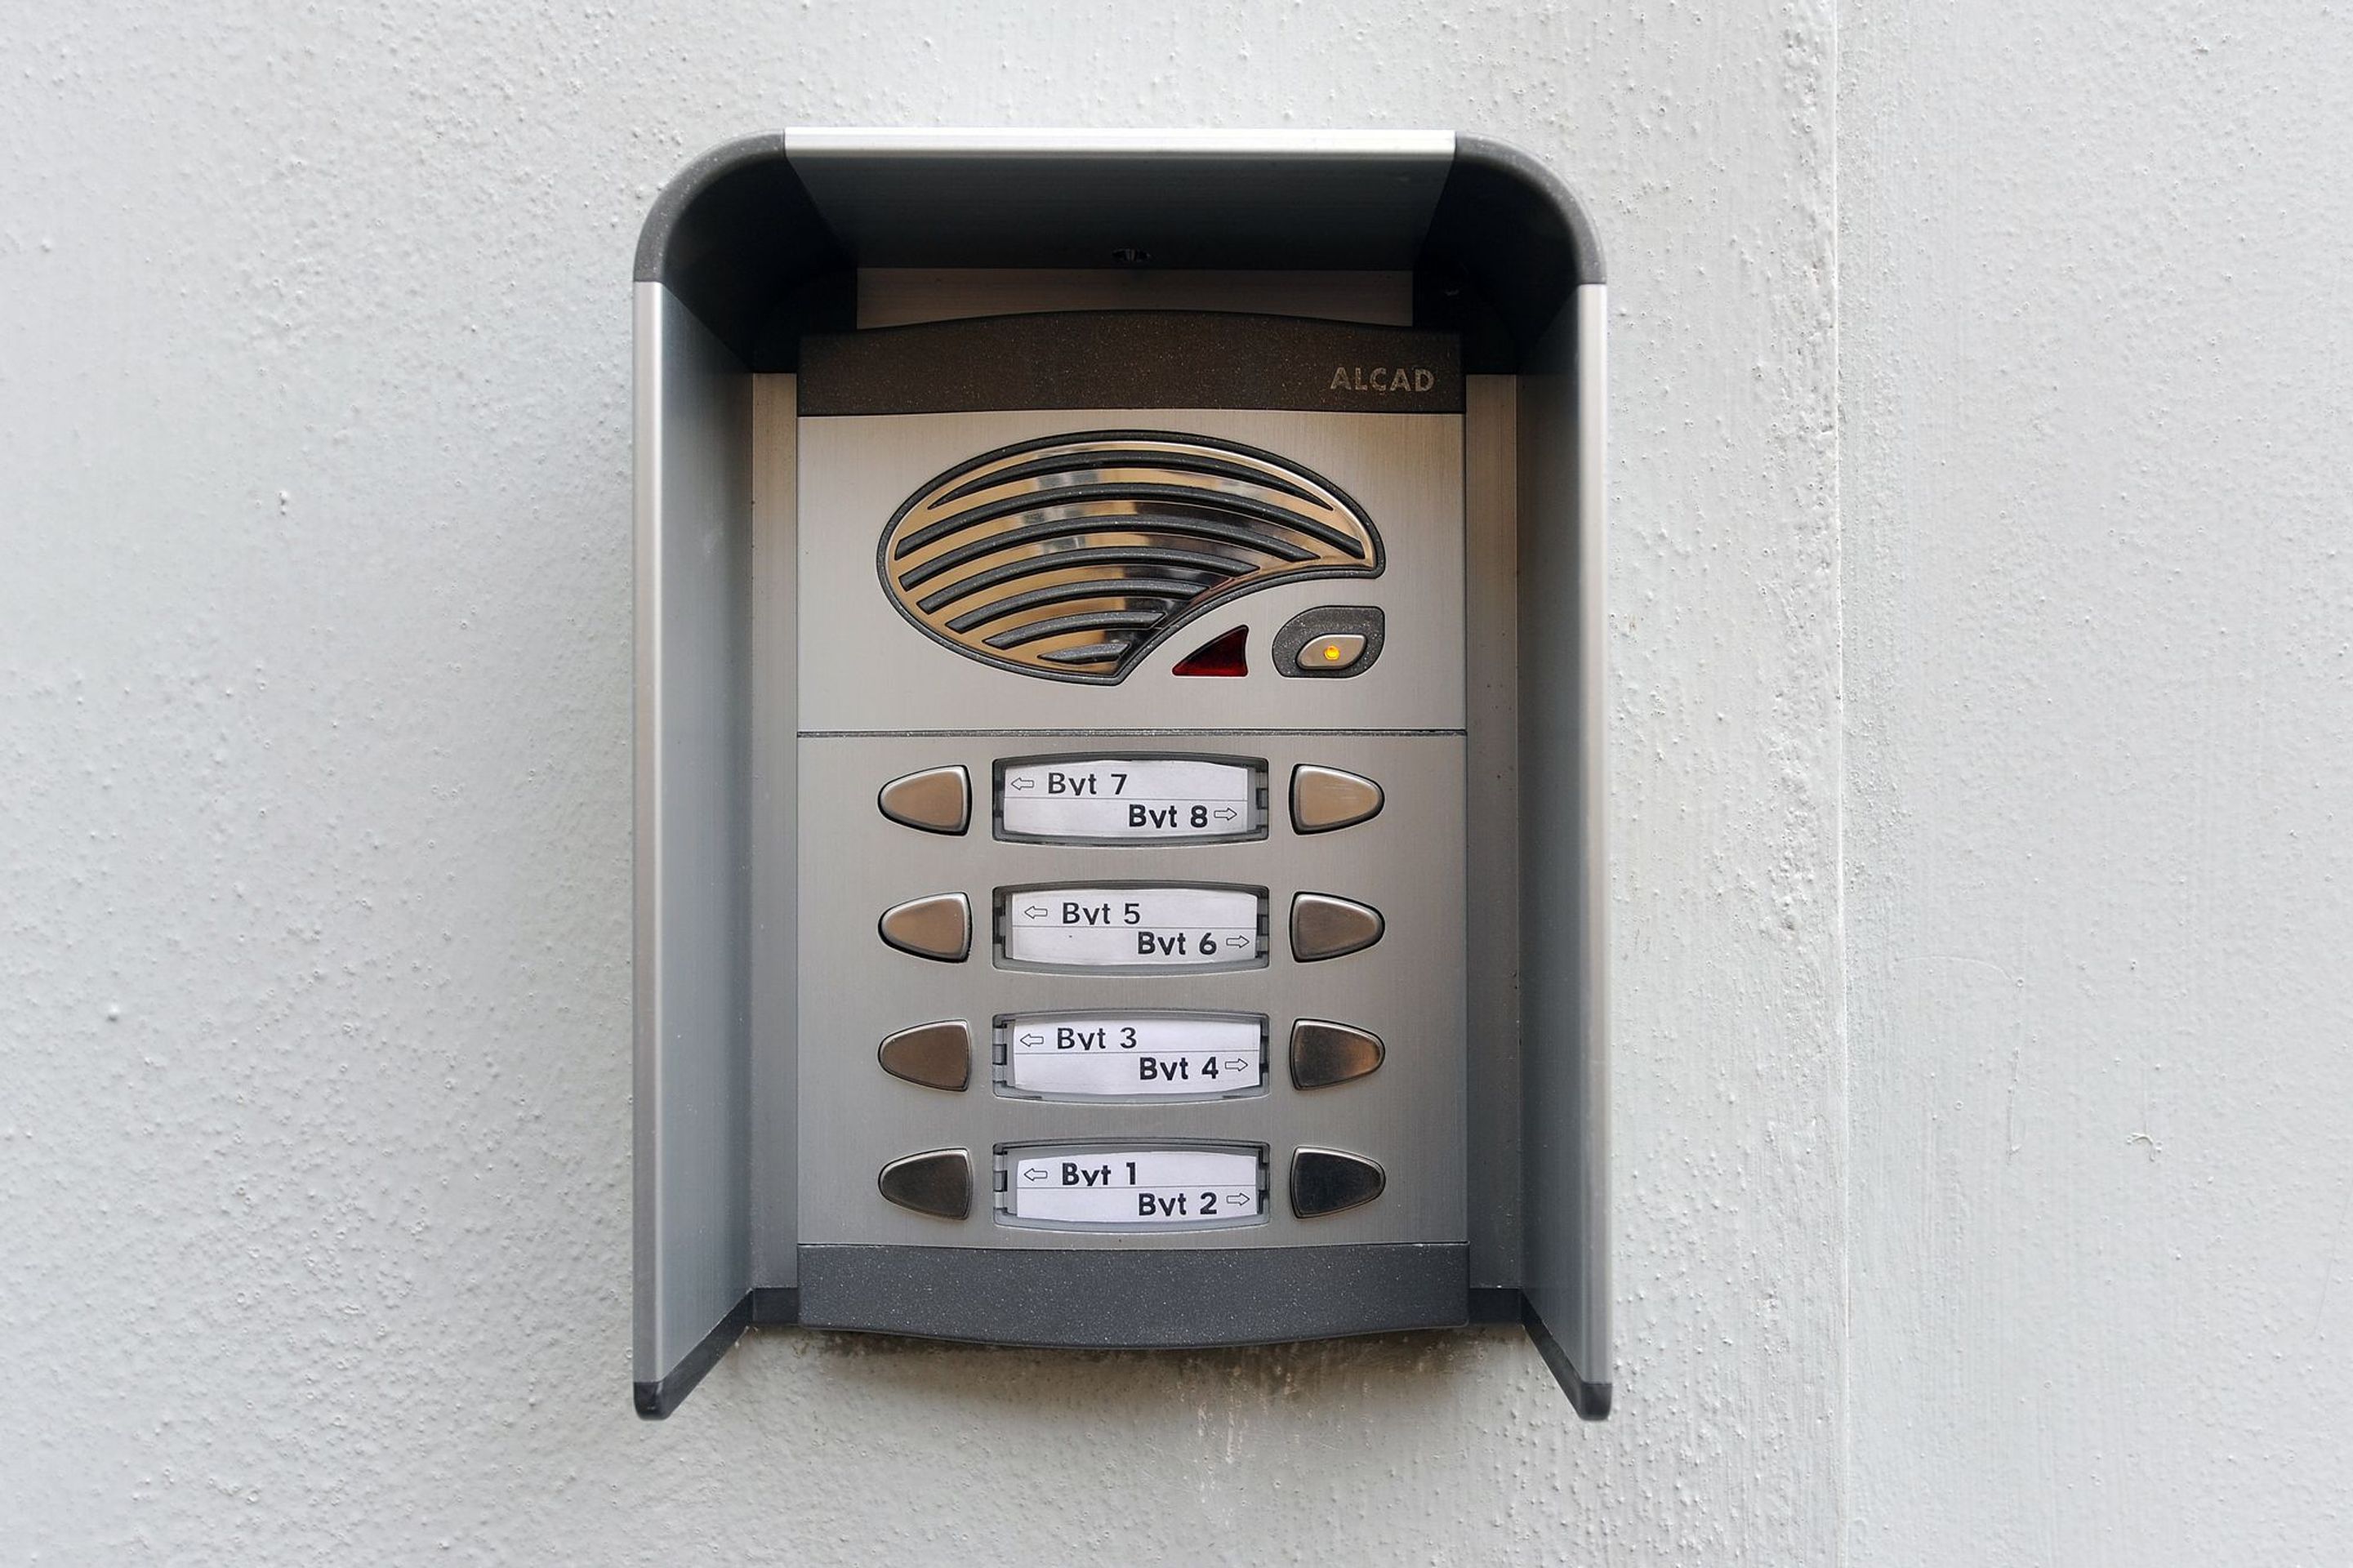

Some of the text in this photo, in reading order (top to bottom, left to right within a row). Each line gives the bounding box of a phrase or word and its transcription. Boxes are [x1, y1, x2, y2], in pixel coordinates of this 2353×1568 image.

[1330, 367, 1435, 392] ALCAD
[1111, 773, 1128, 795] 7
[1190, 804, 1208, 828] 8
[1124, 902, 1141, 925] 5
[1199, 932, 1217, 956] 6
[1120, 1027, 1137, 1049] 3
[1201, 1056, 1219, 1080] 4
[1125, 1161, 1136, 1186] 1
[1200, 1192, 1218, 1215] 2
